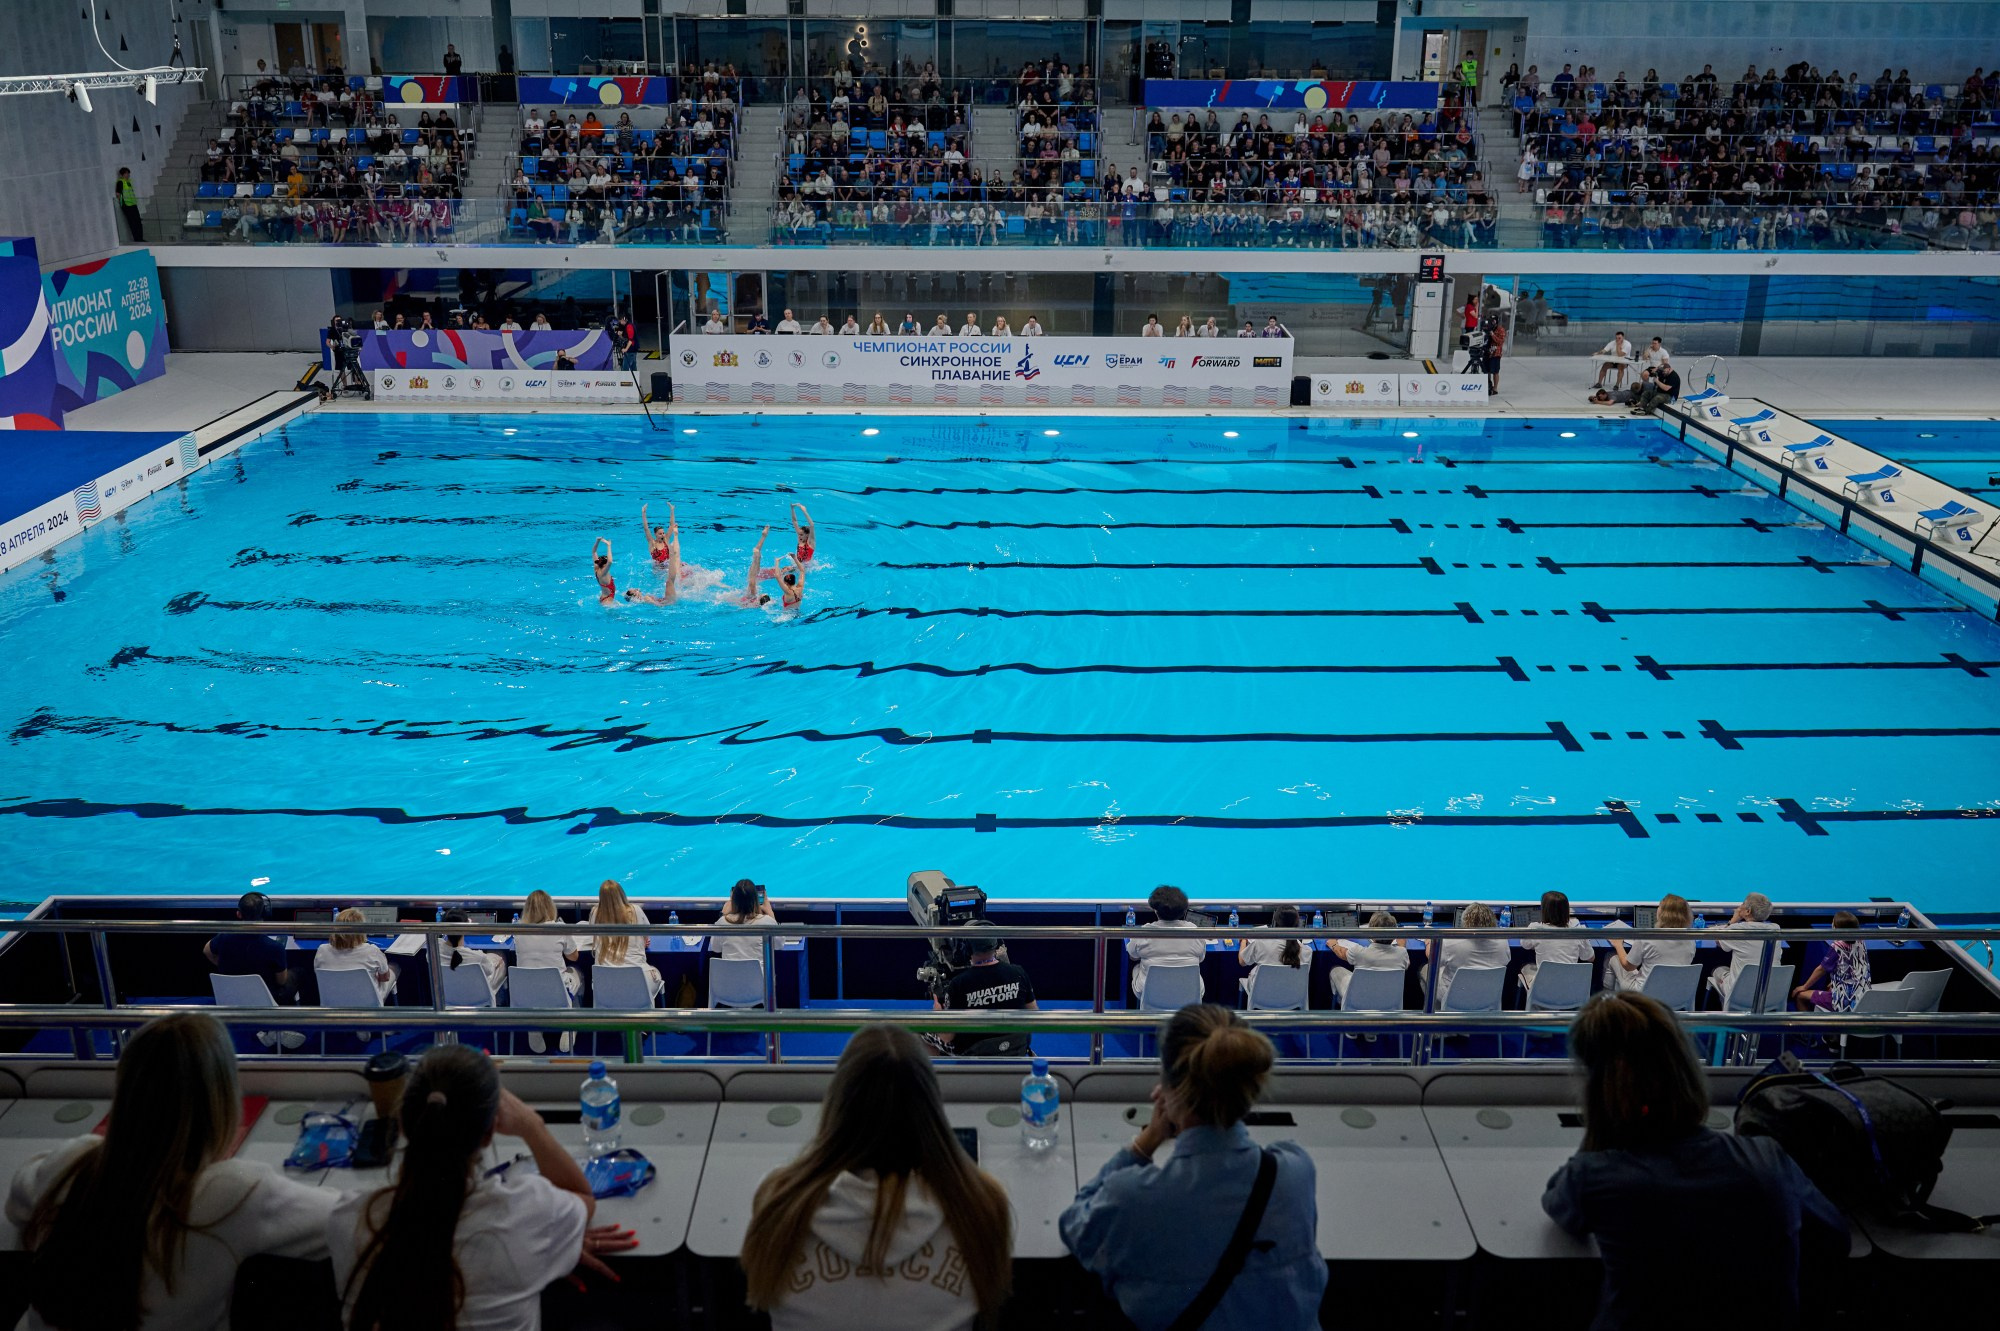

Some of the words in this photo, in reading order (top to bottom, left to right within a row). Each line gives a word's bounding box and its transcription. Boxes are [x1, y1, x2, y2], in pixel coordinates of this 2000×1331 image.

[128, 276, 148, 292] 22-28
[121, 289, 150, 308] АПРЕЛЯ
[129, 301, 152, 320] 2024
[51, 310, 118, 351] РОССИИ
[853, 342, 946, 353] ЧЕМПИОНАТ
[949, 342, 1012, 353] РОССИИ
[900, 356, 1002, 367] СИНХРОННОЕ
[1191, 355, 1240, 368] FORWARD
[931, 370, 1011, 381] ПЛАВАНИЕ
[1712, 408, 1718, 416] 9
[1761, 432, 1767, 440] 8
[1817, 460, 1824, 468] 7
[1883, 492, 1890, 501] 6
[0, 541, 7, 557] 8
[9, 522, 46, 551] АПРЕЛЯ
[46, 510, 69, 531] 2024
[1960, 530, 1967, 539] 5
[967, 990, 1019, 1007] FACTORY
